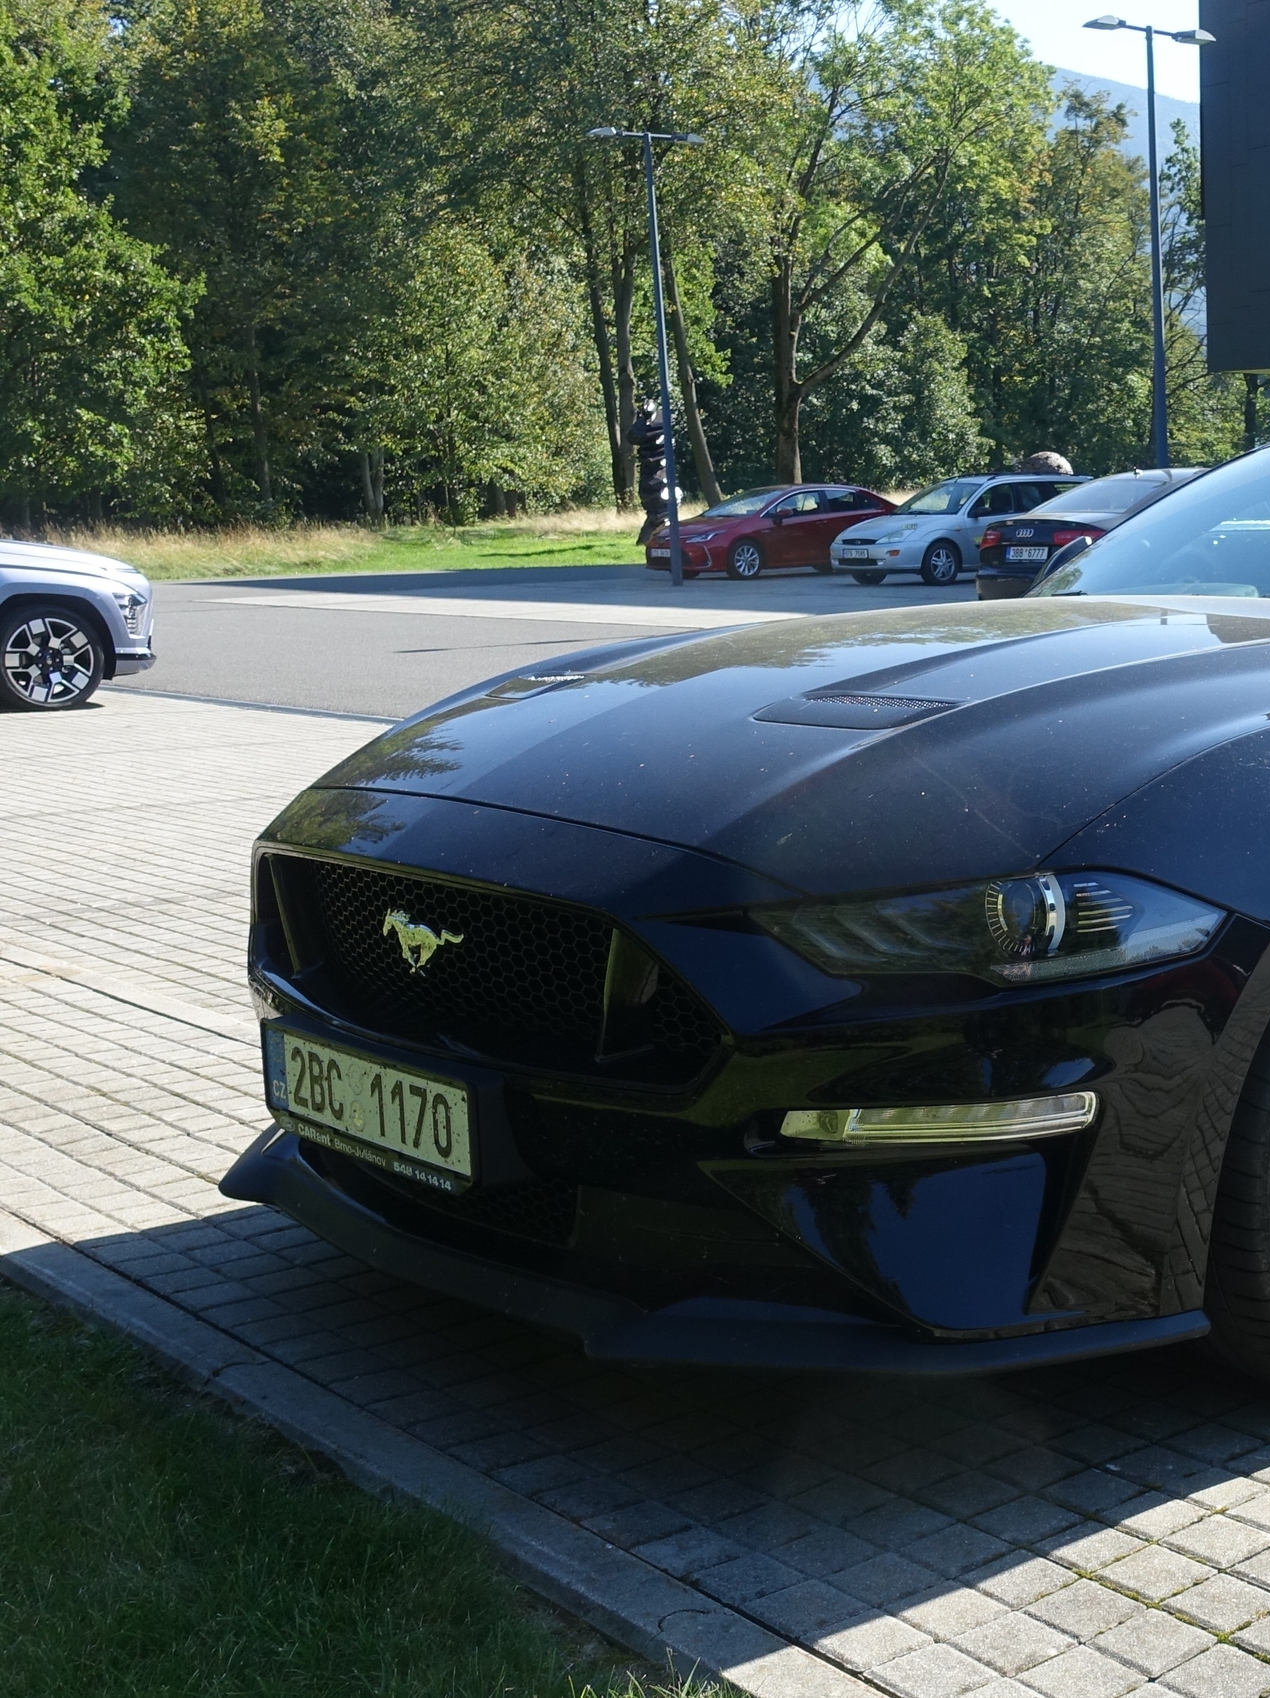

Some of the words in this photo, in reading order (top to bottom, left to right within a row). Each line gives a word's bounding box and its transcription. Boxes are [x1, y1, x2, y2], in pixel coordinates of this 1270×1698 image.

[1028, 548, 1045, 558] 6777
[272, 1080, 287, 1100] CZ
[291, 1046, 344, 1121] 2BC
[370, 1073, 453, 1158] 1170
